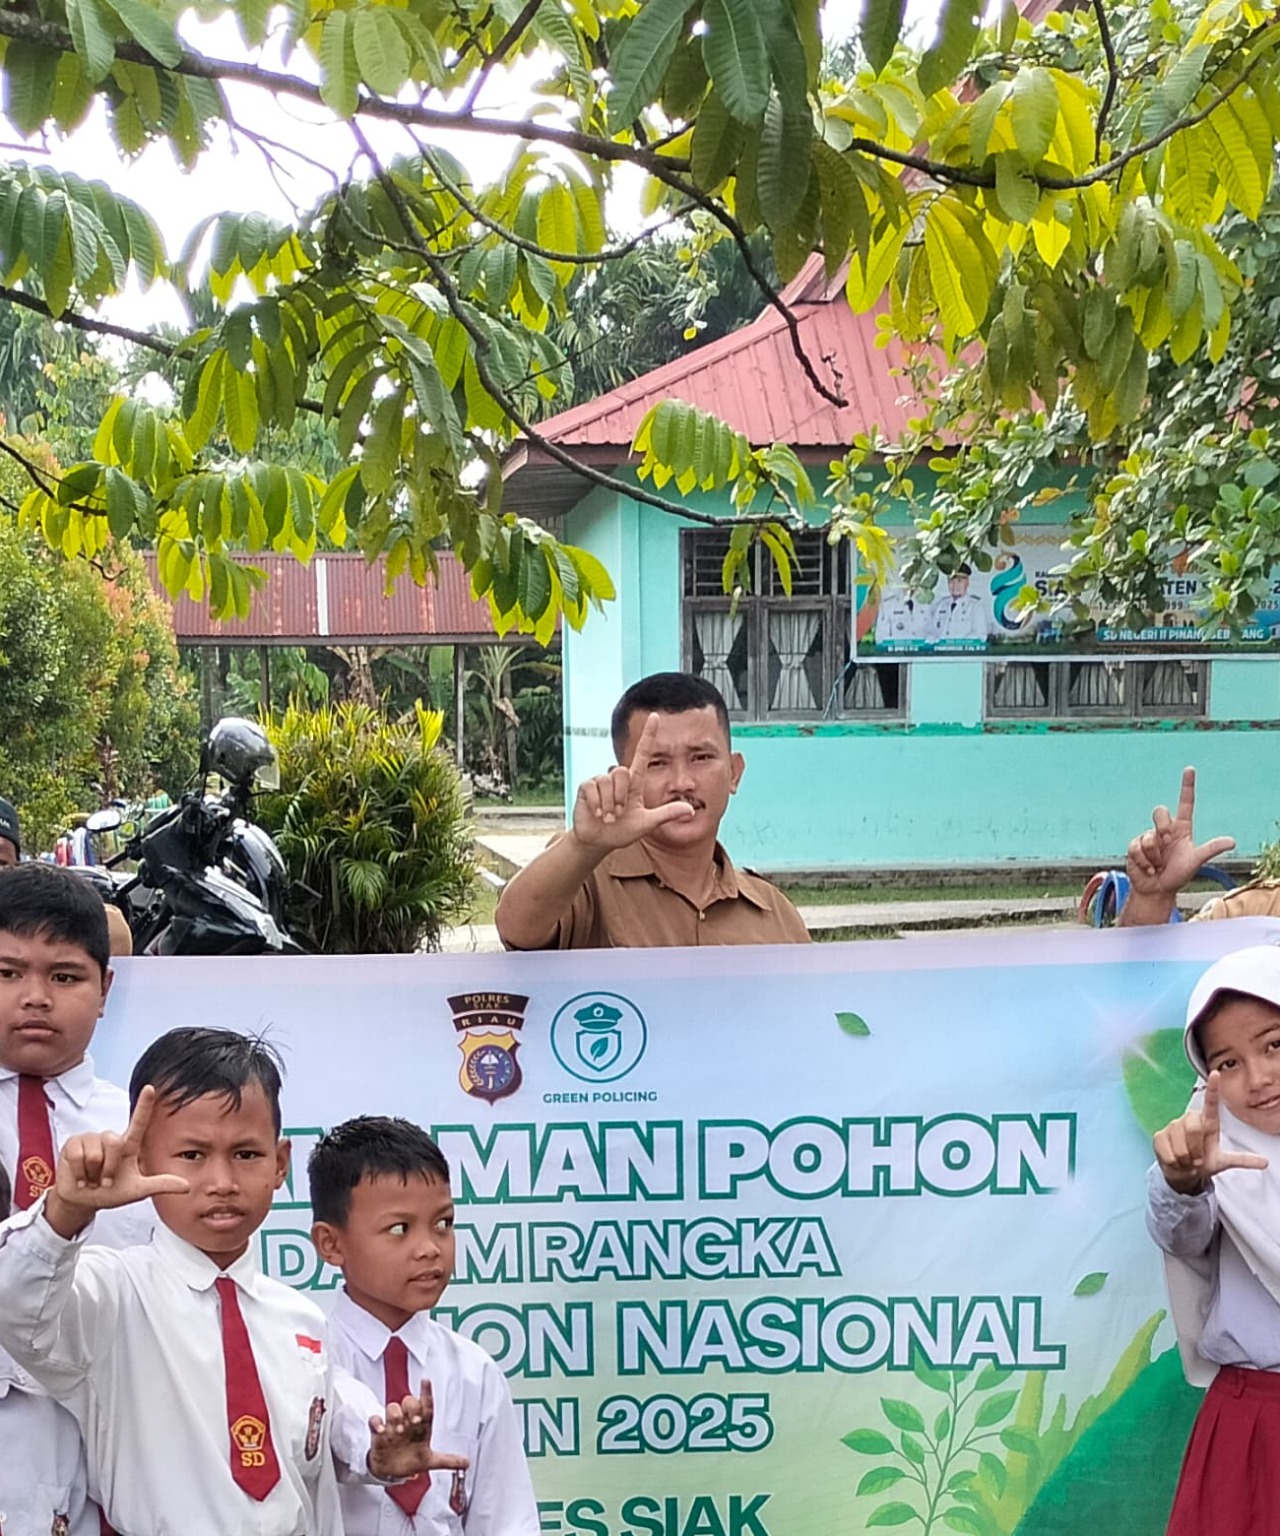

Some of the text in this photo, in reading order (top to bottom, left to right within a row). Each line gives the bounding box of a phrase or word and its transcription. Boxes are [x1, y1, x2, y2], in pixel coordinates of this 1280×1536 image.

[464, 993, 510, 1005] POLRES
[473, 1002, 500, 1010] SIAK
[461, 1015, 517, 1028] RIAU
[542, 1091, 658, 1104] GREEN POLICING
[697, 1112, 1078, 1201] POHON
[525, 1216, 843, 1285] RANGKA
[617, 1295, 1067, 1376] NASIONAL
[597, 1392, 775, 1454] 2025
[241, 1451, 266, 1468] SD
